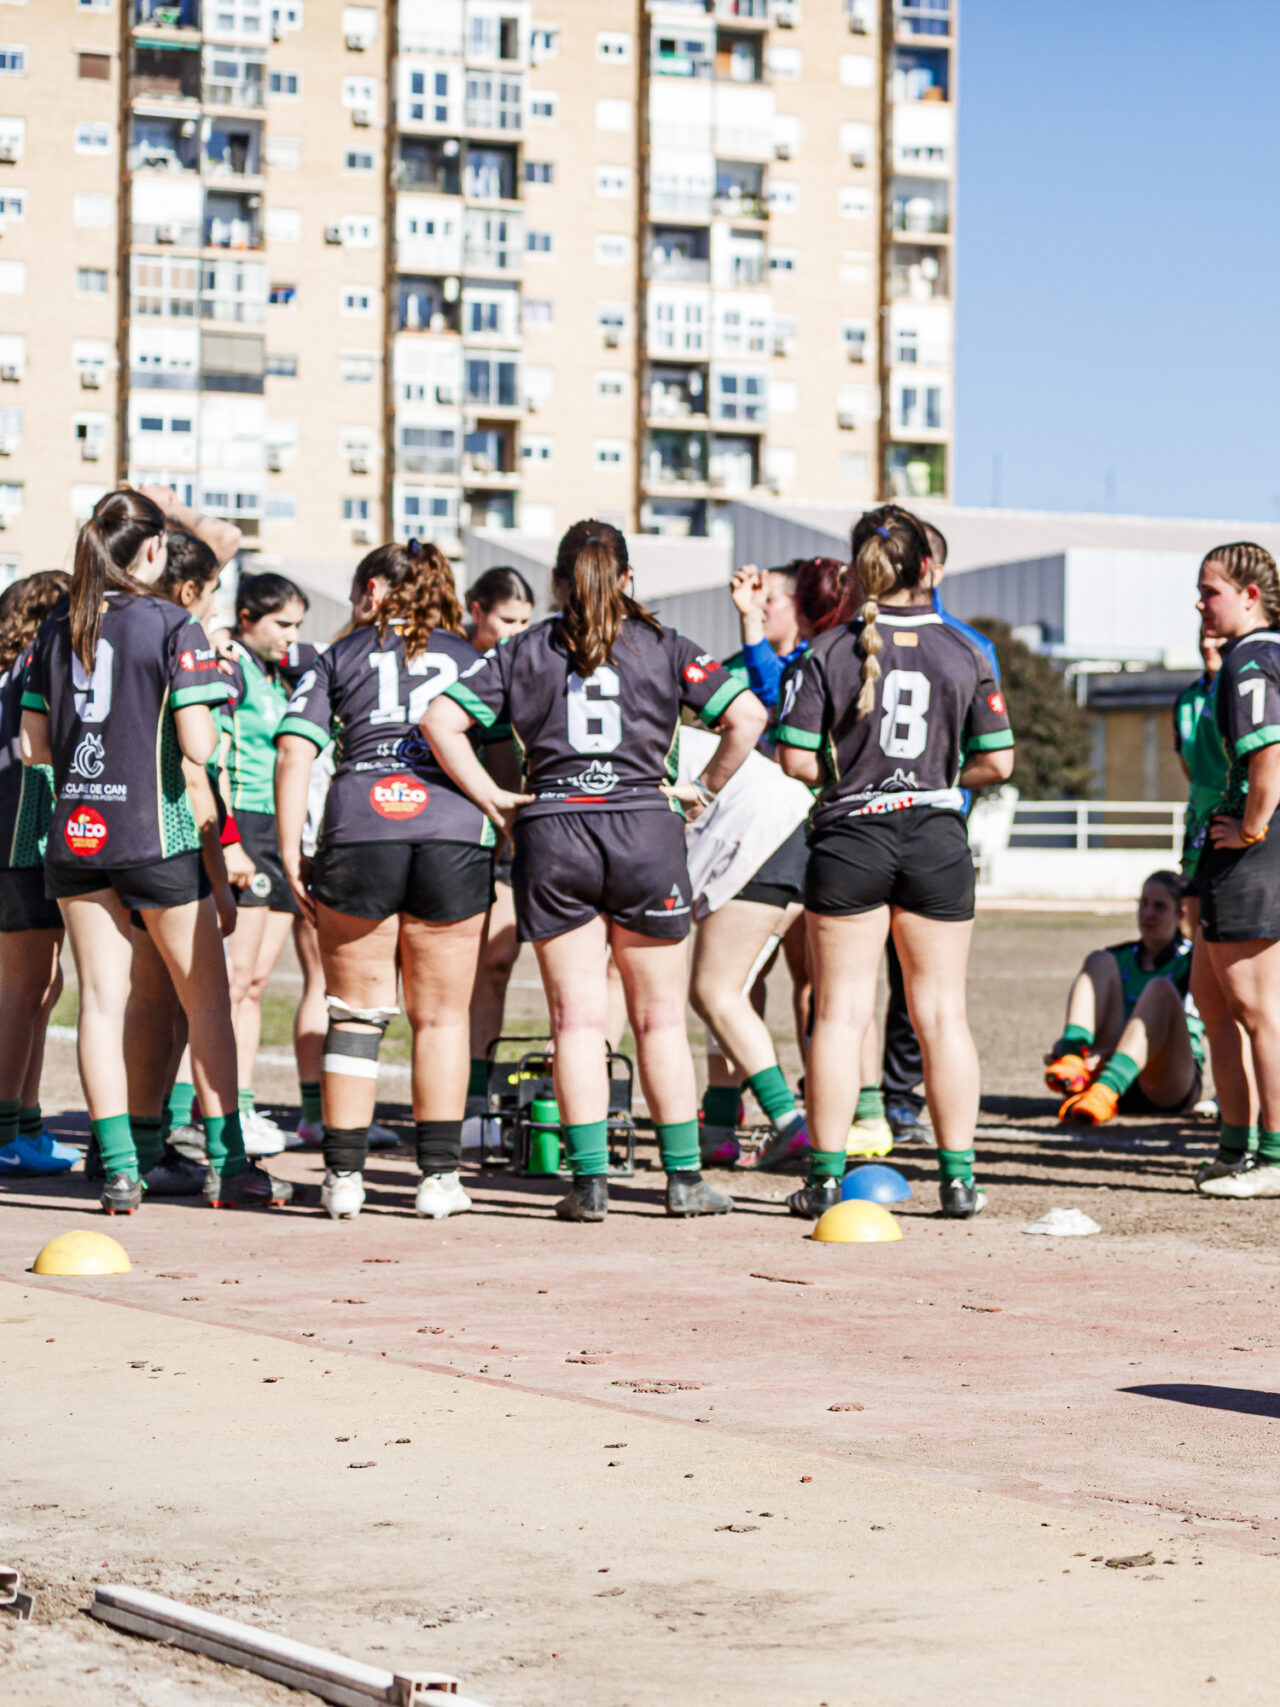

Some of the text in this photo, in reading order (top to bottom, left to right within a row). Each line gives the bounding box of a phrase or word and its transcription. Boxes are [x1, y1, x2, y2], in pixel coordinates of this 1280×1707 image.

[368, 650, 459, 725] 12
[567, 666, 622, 754] 6
[879, 669, 931, 760] 8
[67, 820, 106, 837] tuco
[374, 786, 427, 803] tuco
